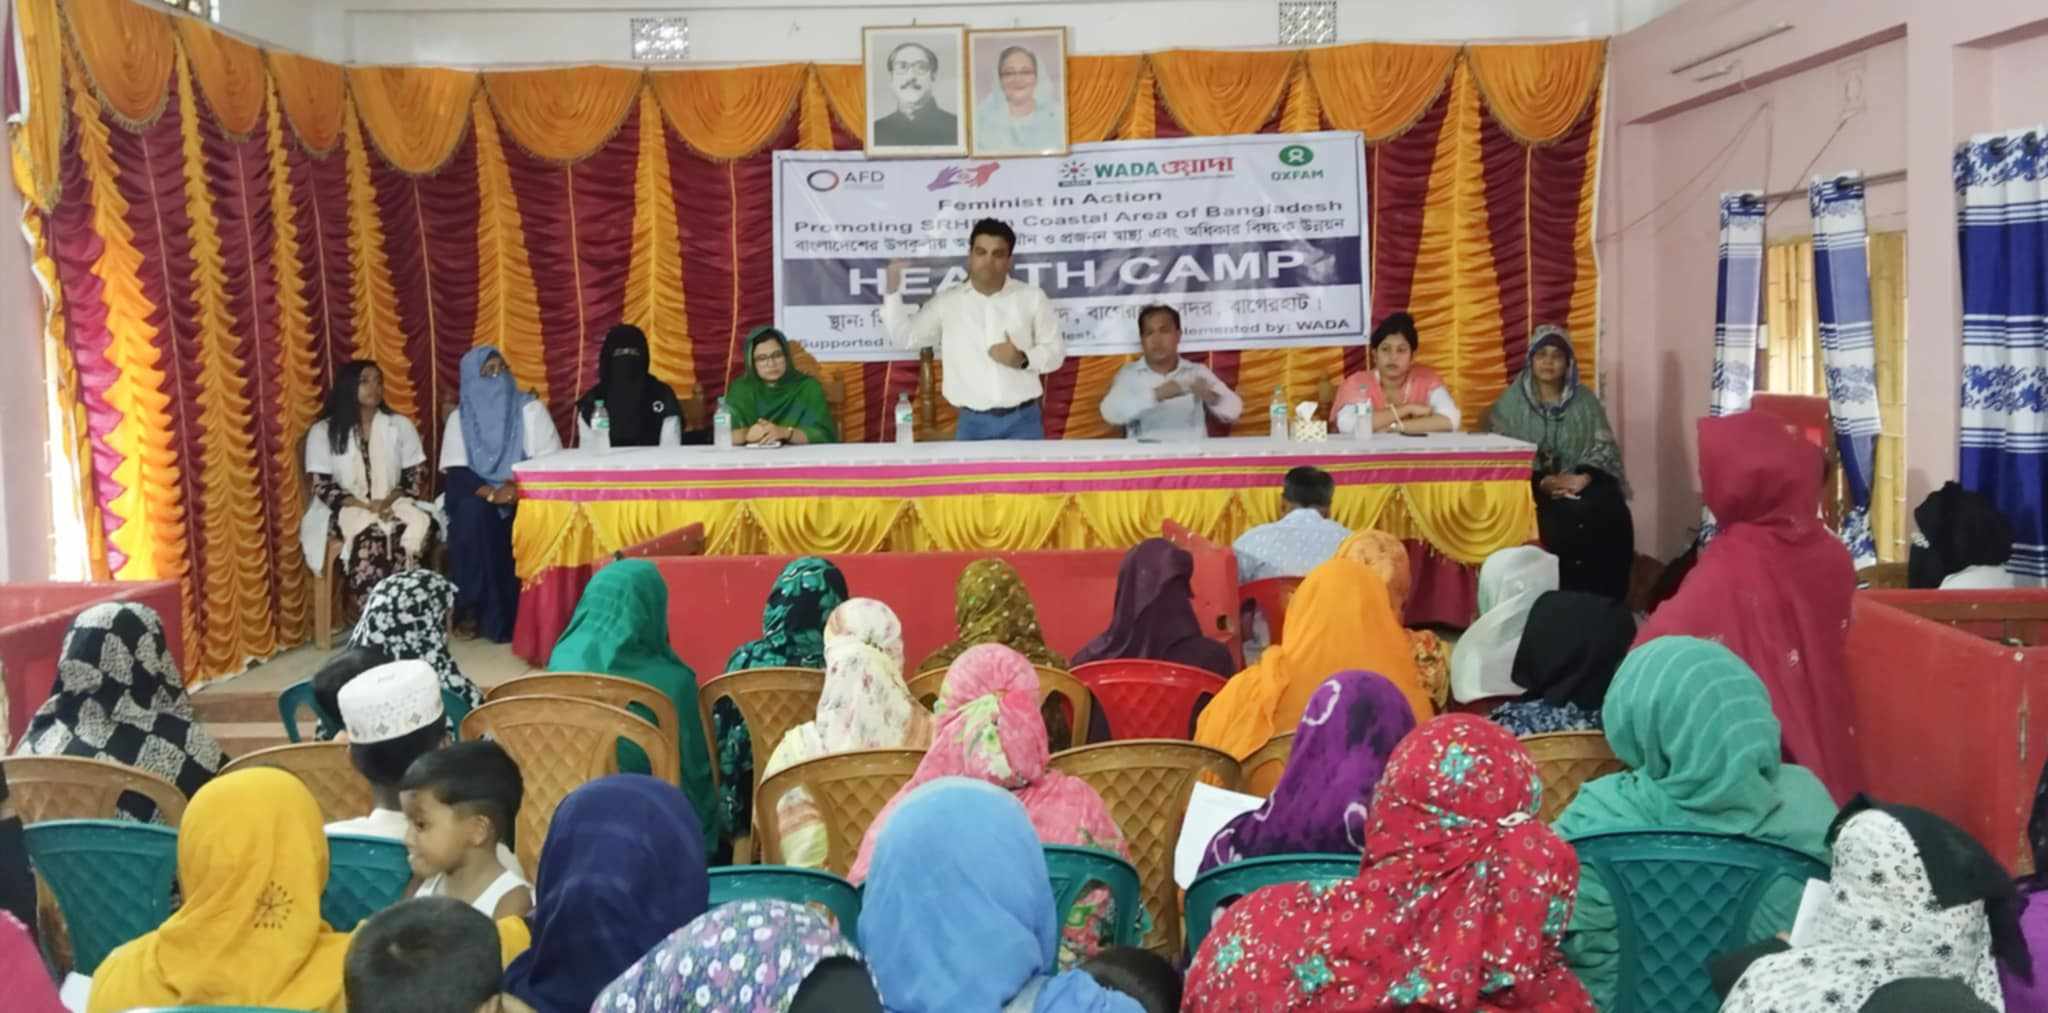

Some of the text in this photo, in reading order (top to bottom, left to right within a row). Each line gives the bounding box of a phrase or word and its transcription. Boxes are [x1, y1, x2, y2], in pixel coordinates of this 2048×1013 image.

[844, 170, 885, 183] AFD
[1094, 161, 1159, 178] WADA
[1271, 169, 1324, 182] OXFAM
[938, 192, 1162, 211] Feminist in Action
[794, 219, 912, 235] Promoting
[1023, 212, 1107, 227] Coastal
[1115, 211, 1168, 223] Area
[1176, 206, 1198, 219] of
[1206, 200, 1343, 218] Bangladesh
[849, 250, 1305, 296] HEATH CAMP
[1296, 318, 1349, 332] WADA
